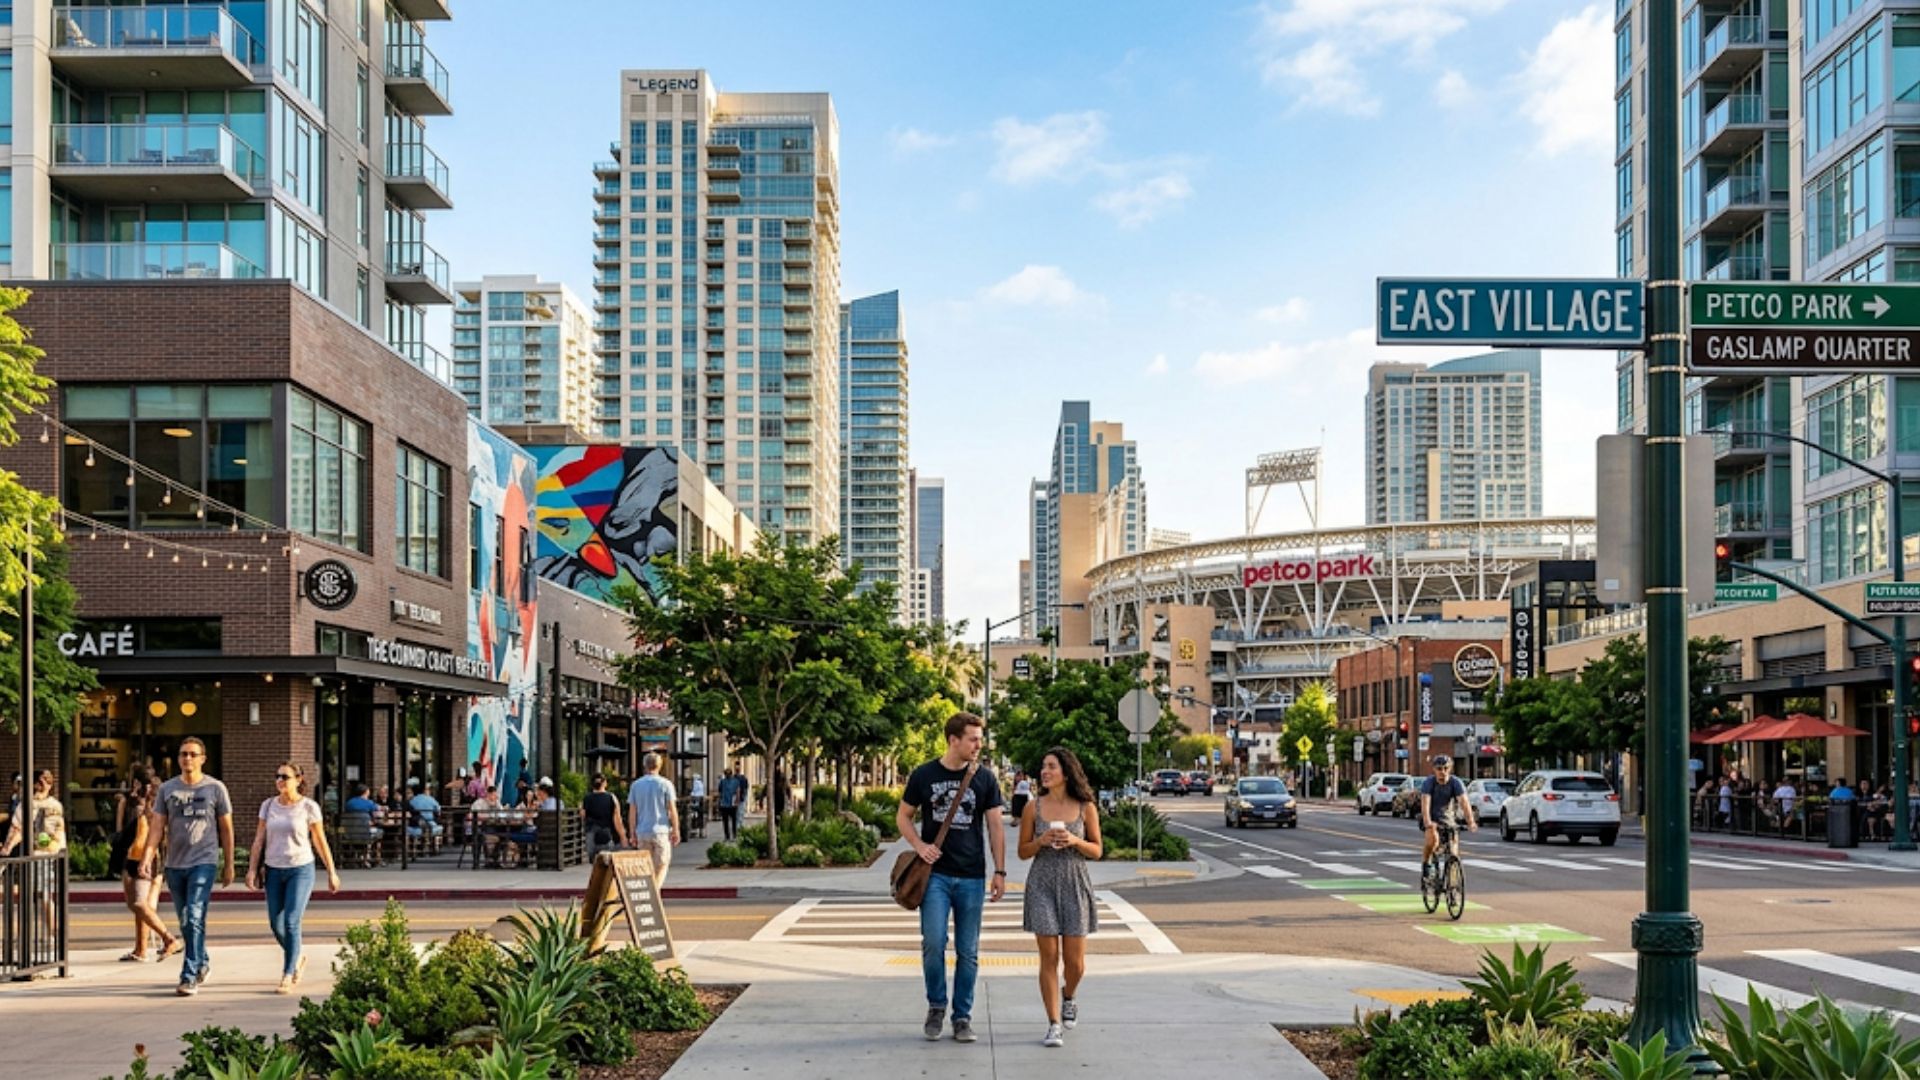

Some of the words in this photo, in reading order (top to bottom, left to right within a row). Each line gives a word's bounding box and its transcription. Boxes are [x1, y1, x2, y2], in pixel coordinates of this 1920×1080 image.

[1389, 288, 1476, 332] EAST
[1489, 288, 1633, 332] VILLAGE
[1706, 293, 1782, 318] PETCO
[1791, 294, 1853, 319] PARK
[1706, 335, 1806, 360] GASLAMP
[1814, 337, 1911, 362] QUARTER
[1243, 560, 1312, 588] petco
[1316, 554, 1374, 584] park
[57, 624, 135, 656] CAFÉ
[367, 637, 388, 663] THE
